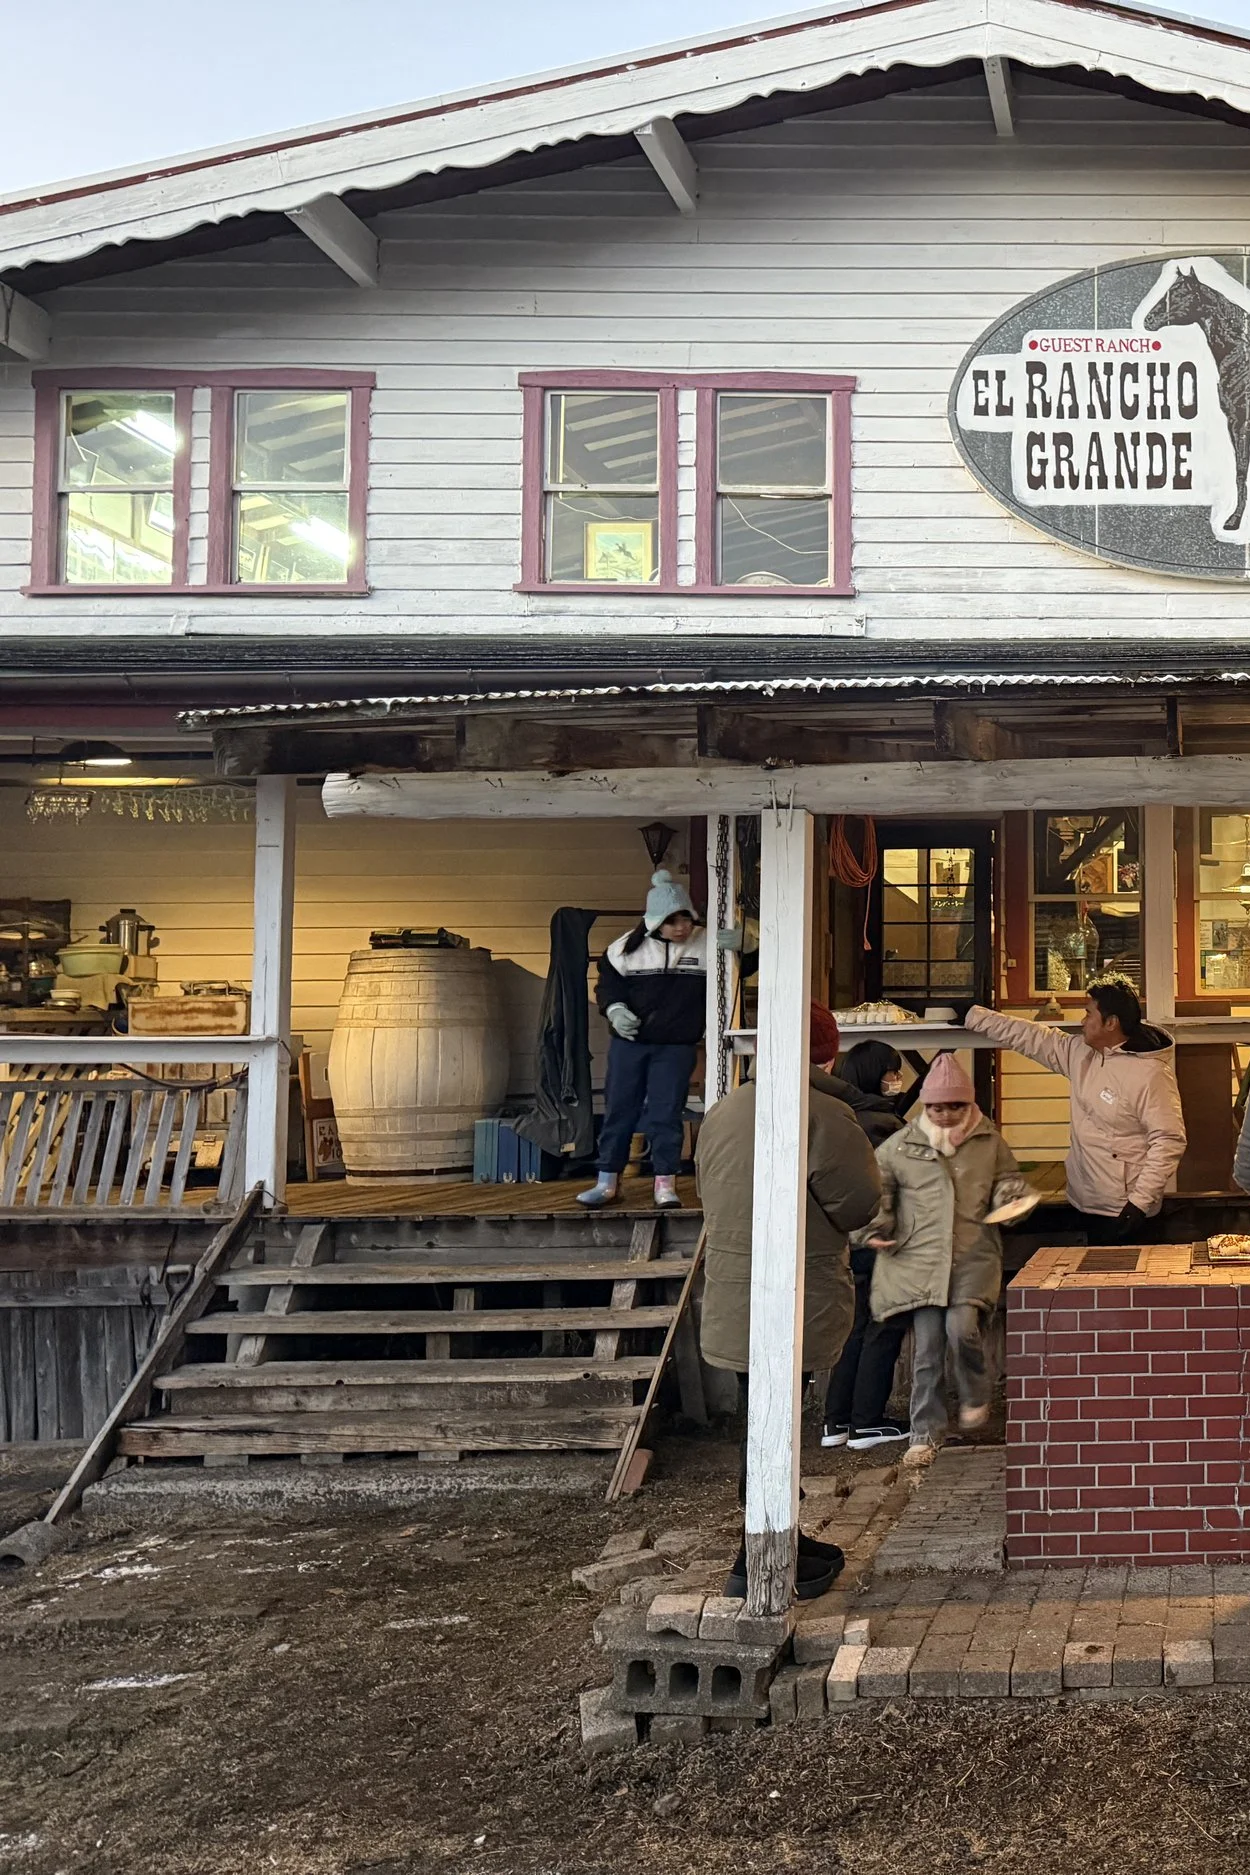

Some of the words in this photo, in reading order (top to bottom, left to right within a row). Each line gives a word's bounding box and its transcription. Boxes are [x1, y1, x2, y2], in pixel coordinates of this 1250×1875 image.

[1039, 337, 1093, 353] GUEST
[1095, 338, 1151, 353] RANCH
[972, 369, 1014, 417] EL
[1025, 361, 1198, 420] RANCHO
[1026, 430, 1193, 491] GRANDE
